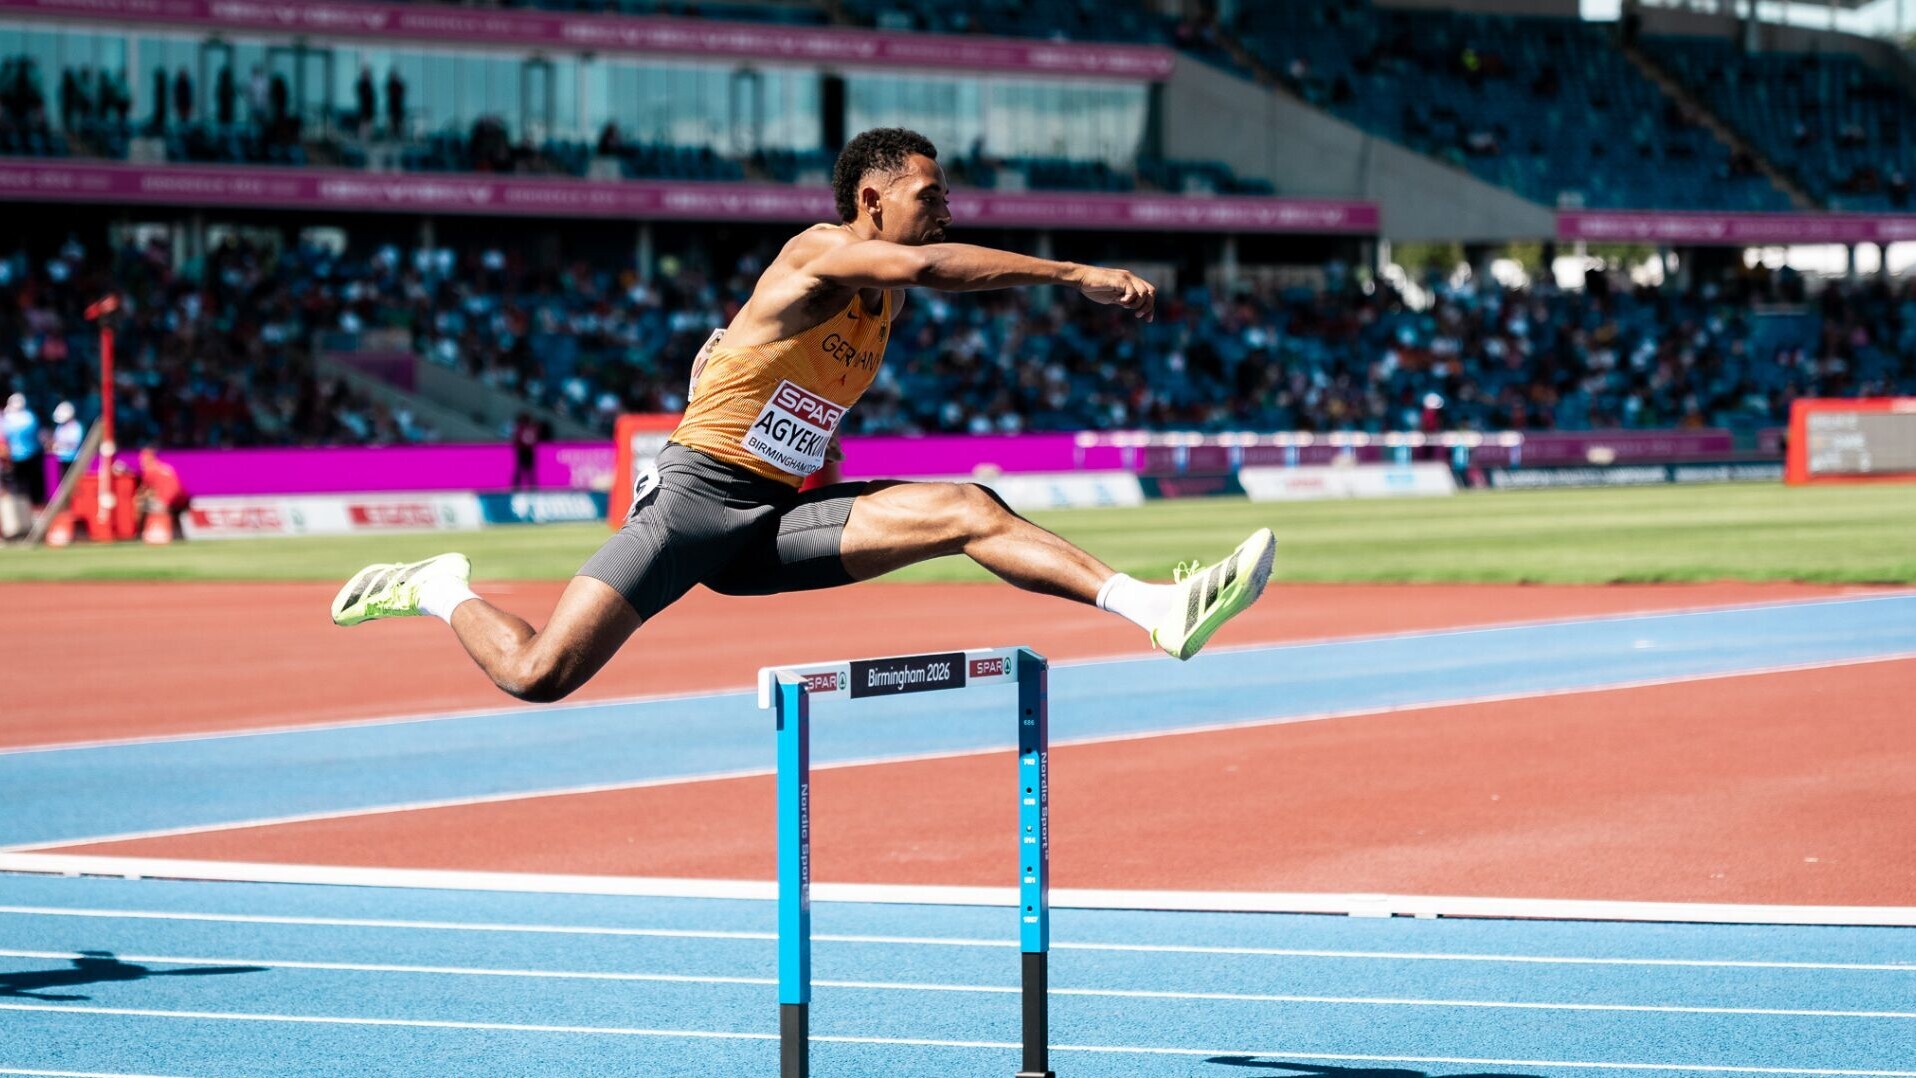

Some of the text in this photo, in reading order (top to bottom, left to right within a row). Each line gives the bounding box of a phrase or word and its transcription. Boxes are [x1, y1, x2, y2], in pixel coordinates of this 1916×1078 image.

[778, 388, 839, 431] SPAR
[868, 662, 950, 691] Birmingham 2026
[976, 658, 1003, 674] SPAR
[808, 675, 837, 690] SPAR
[800, 784, 808, 839] Nordic
